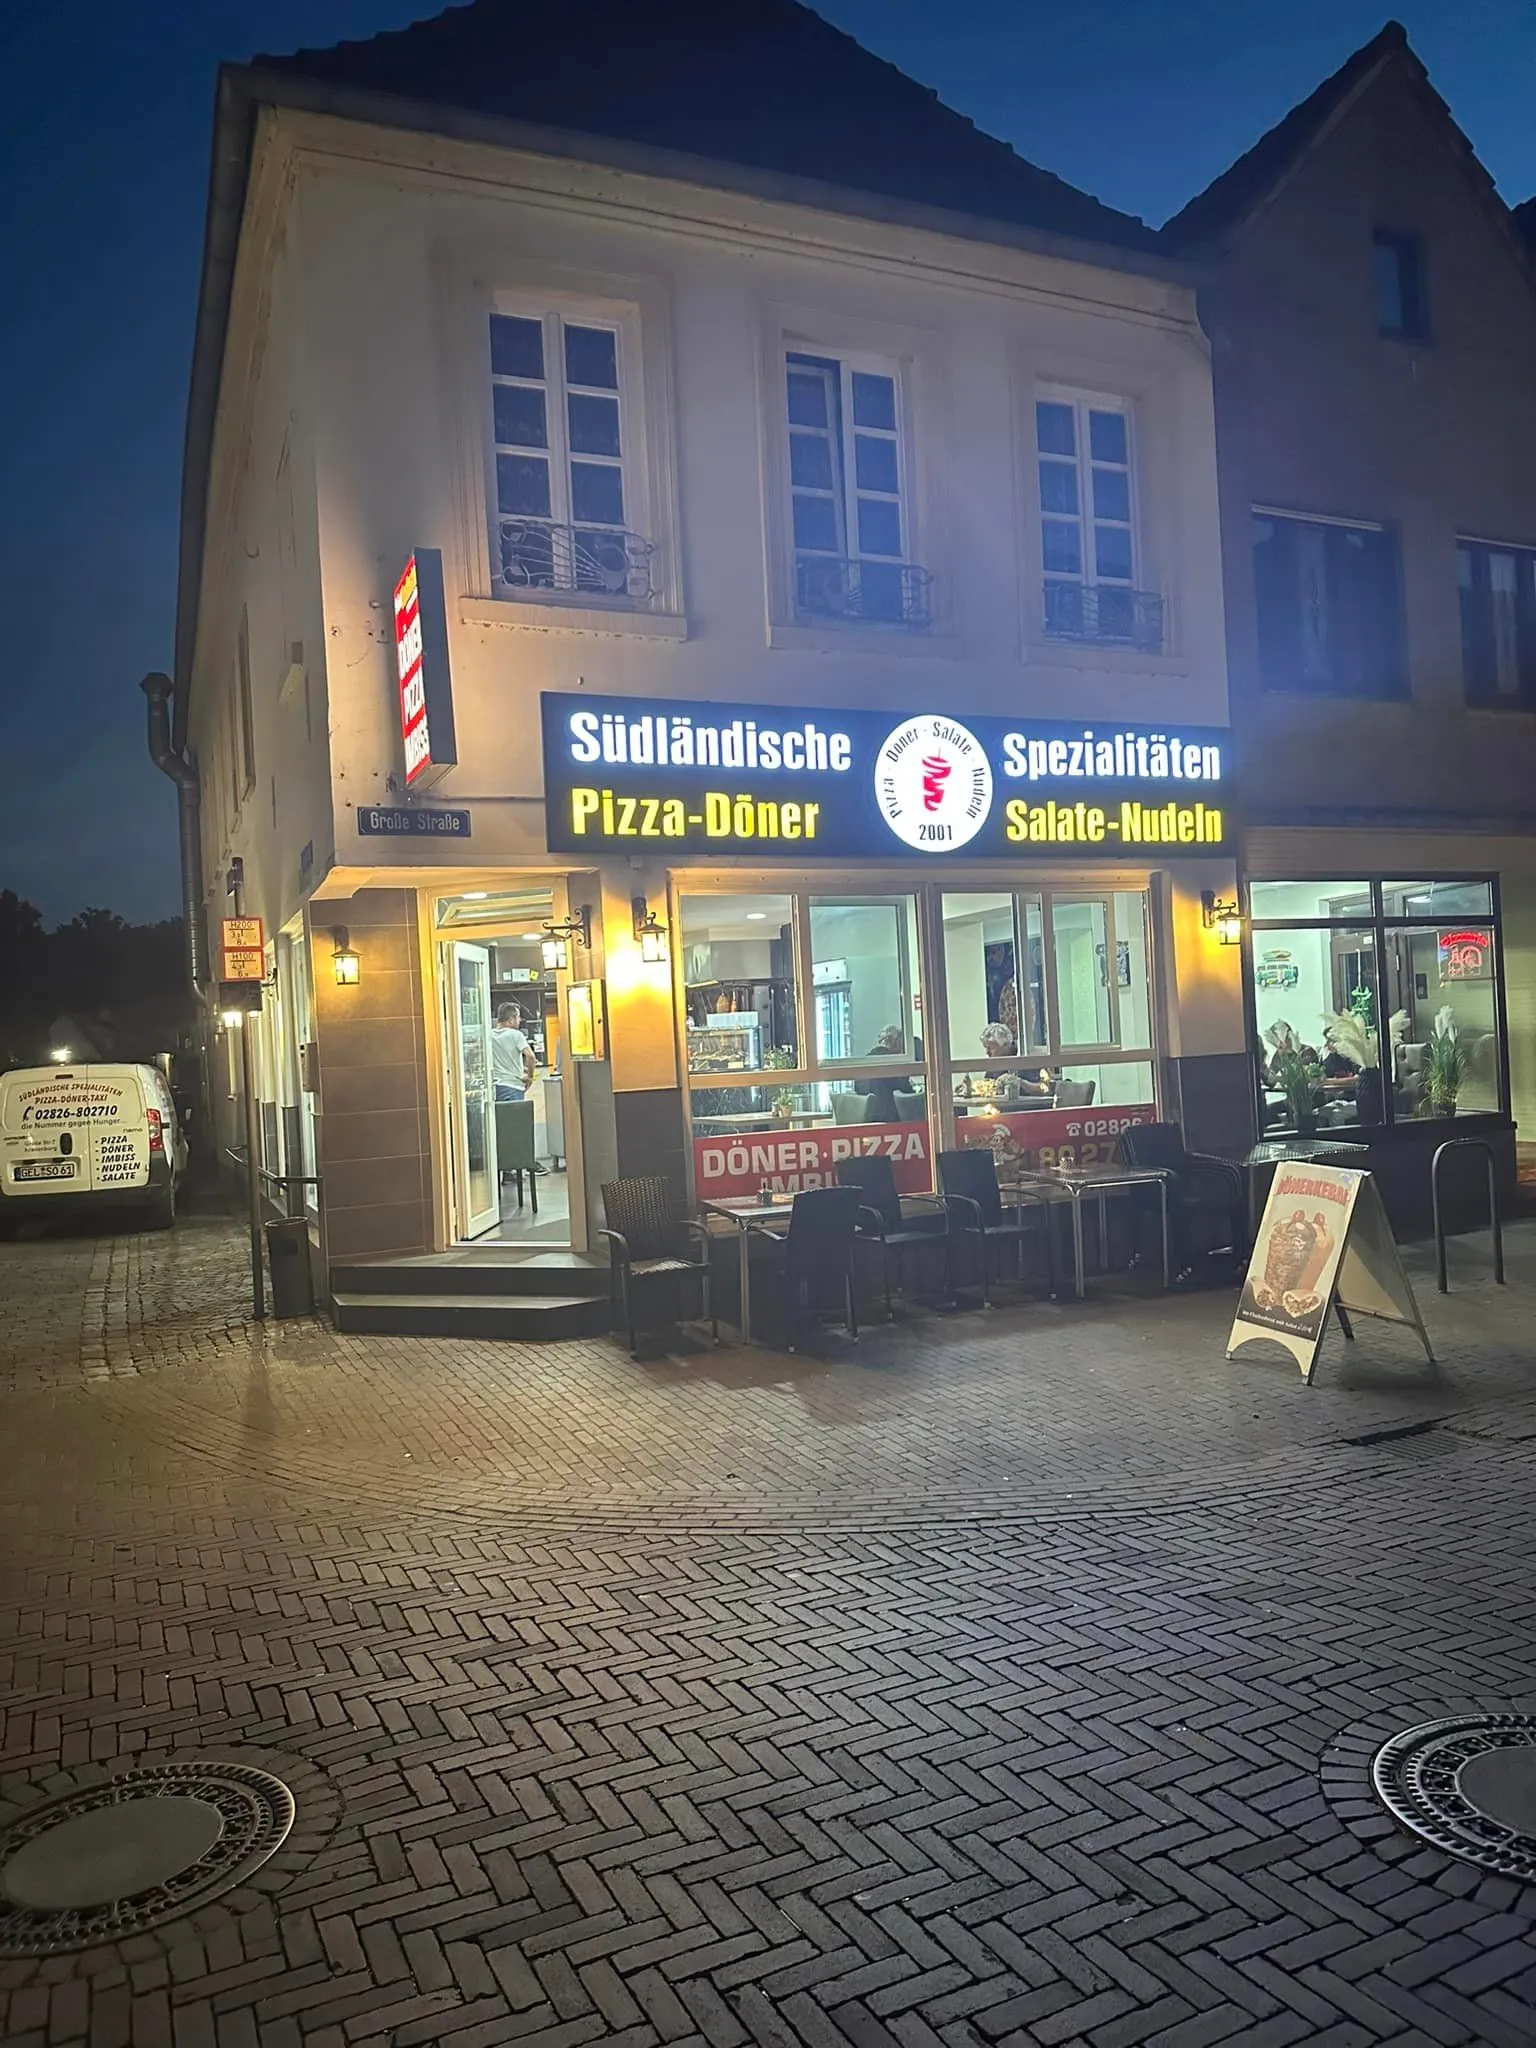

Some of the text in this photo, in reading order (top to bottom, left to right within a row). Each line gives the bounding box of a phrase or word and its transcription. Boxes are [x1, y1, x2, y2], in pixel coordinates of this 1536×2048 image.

[569, 711, 1221, 780] Südländische Spezialitäten
[932, 721, 972, 755] Salate
[965, 767, 986, 819] Nudeln
[370, 811, 460, 831] Große Straße
[571, 787, 1222, 842] Pizza-Döner Salate-Nudeln
[918, 824, 953, 841] 2001
[35, 1105, 118, 1120] 02826-802710
[101, 1135, 128, 1145] PIZZA
[101, 1153, 136, 1163] IMBISS
[702, 1139, 820, 1178] DÖNER
[101, 1162, 141, 1173] NUDELN
[101, 1172, 136, 1182] SALATE
